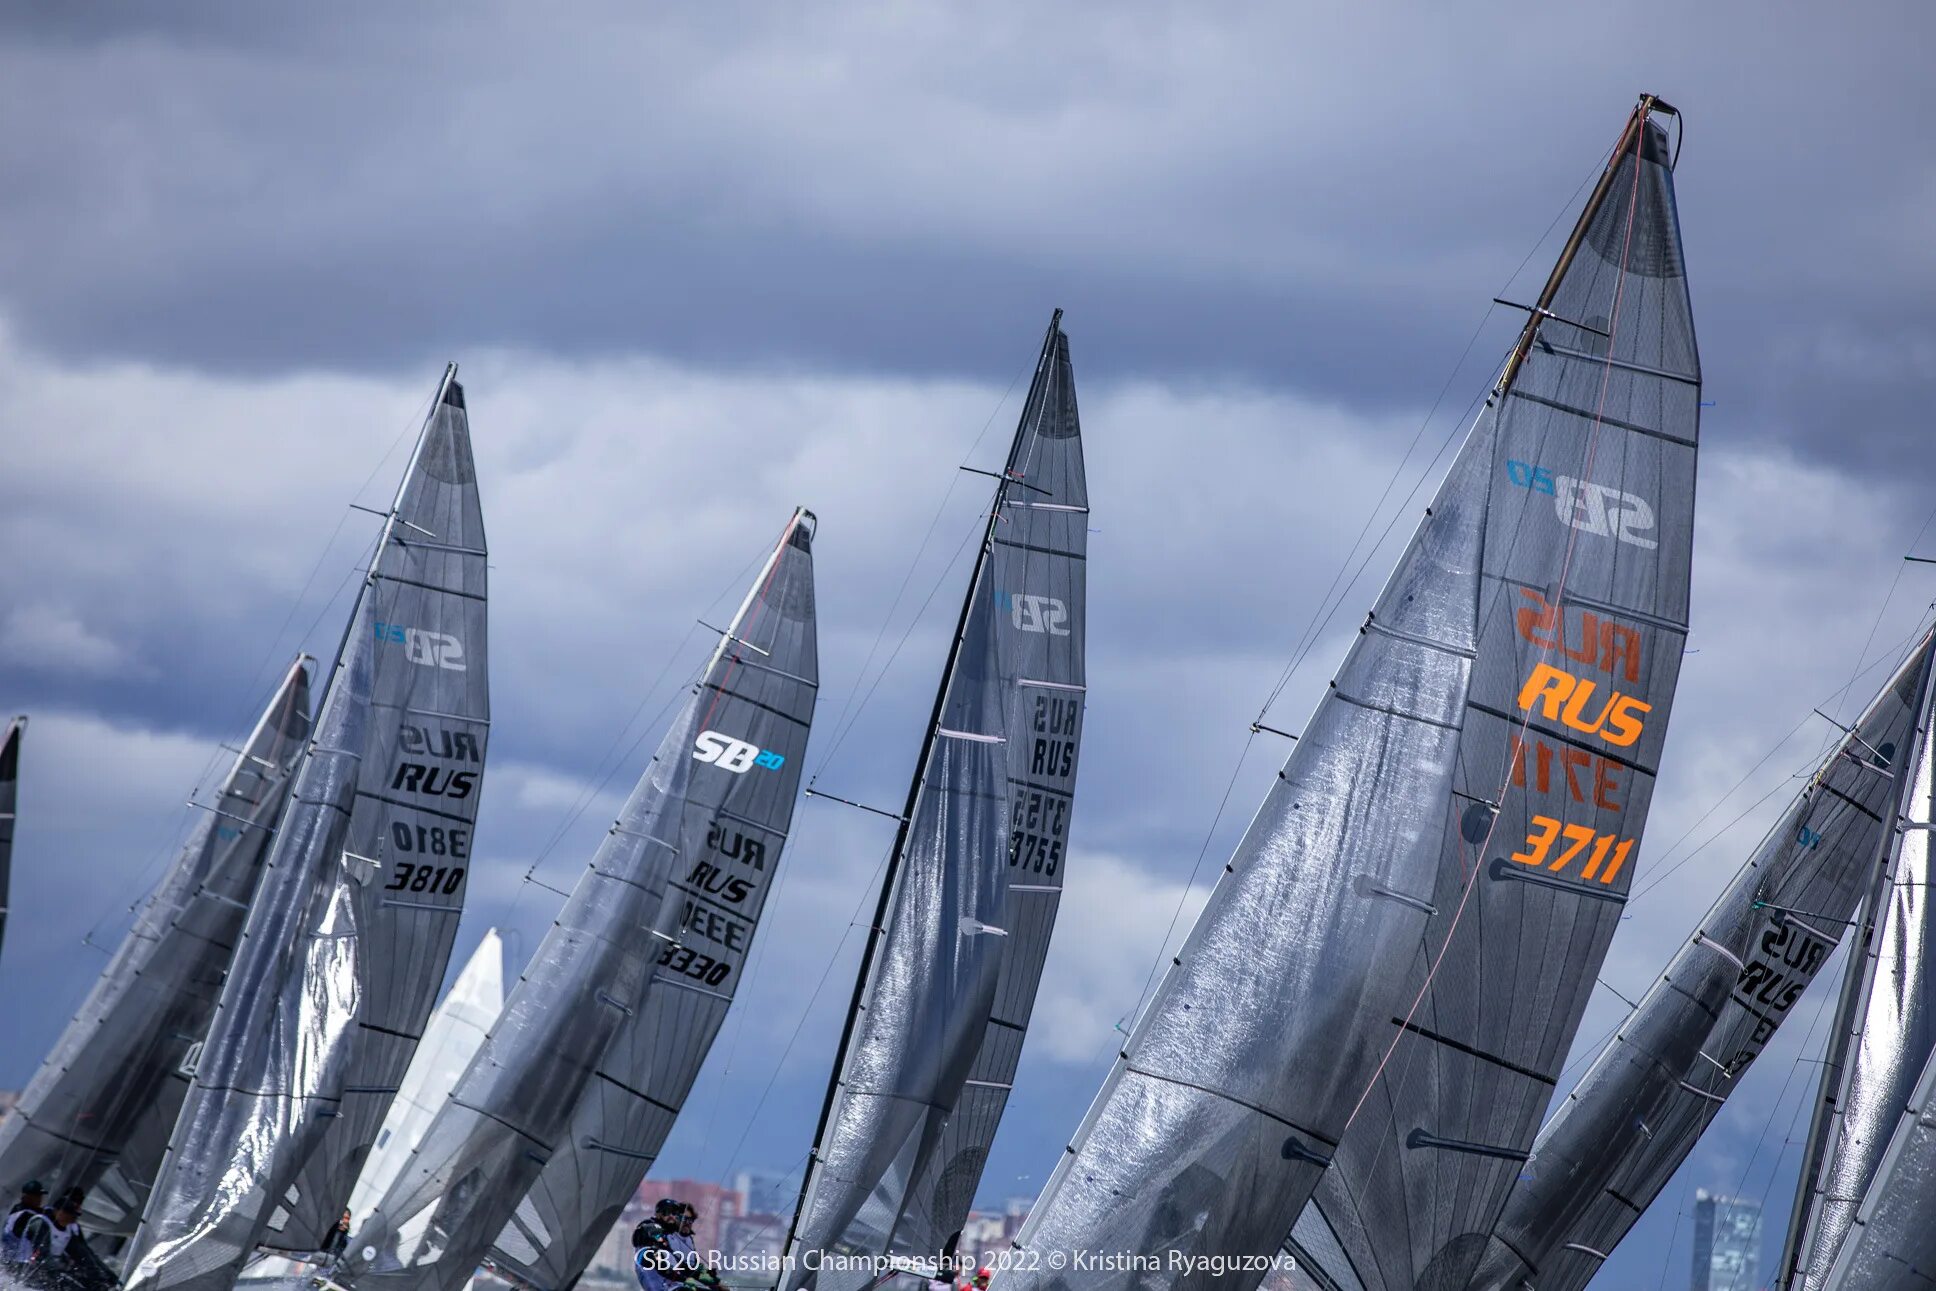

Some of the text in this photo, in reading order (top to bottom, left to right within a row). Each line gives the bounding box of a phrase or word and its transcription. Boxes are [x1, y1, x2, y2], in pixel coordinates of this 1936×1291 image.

[1517, 662, 1652, 748] RUS
[1031, 738, 1075, 778] RUS
[391, 762, 478, 800] RUS
[1009, 831, 1063, 878] 3755
[1511, 814, 1635, 885] 3711
[384, 862, 465, 896] 3810
[686, 860, 756, 904] RUS
[1736, 959, 1805, 1012] RUS
